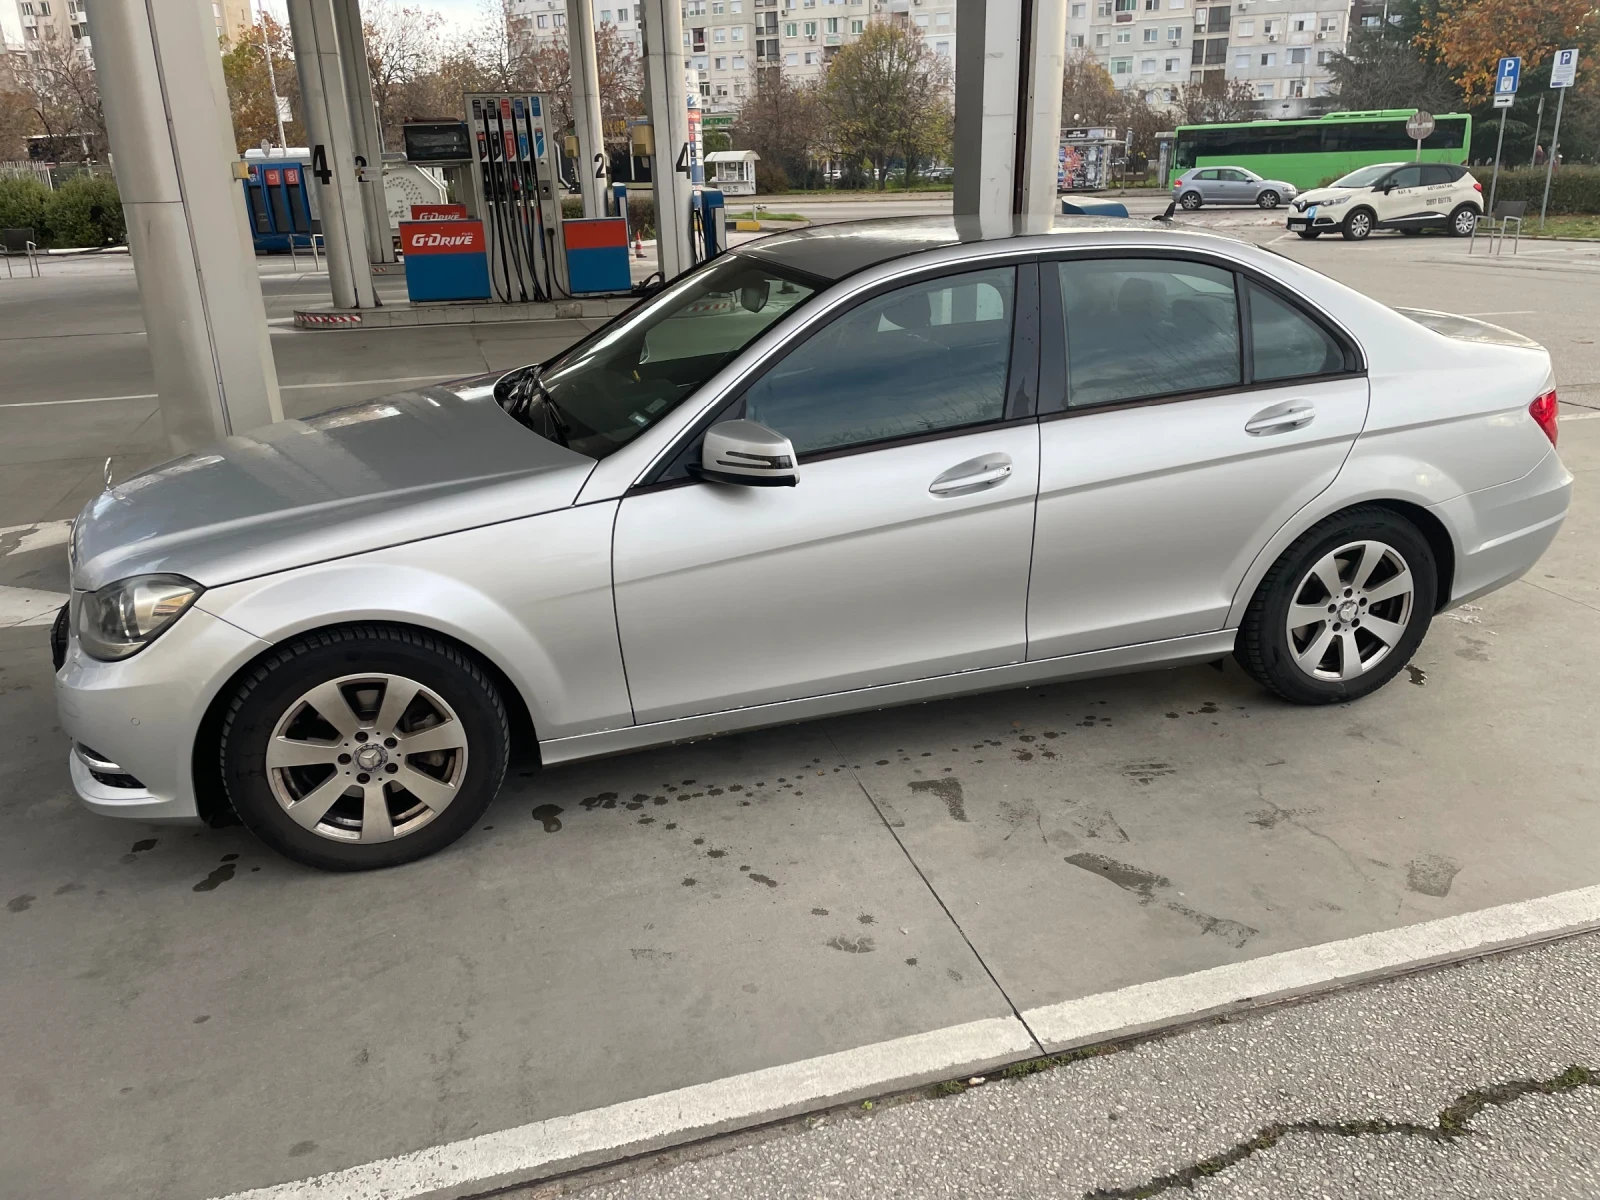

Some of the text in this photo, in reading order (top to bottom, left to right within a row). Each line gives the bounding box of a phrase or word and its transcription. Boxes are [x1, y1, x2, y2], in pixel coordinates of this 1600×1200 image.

[1504, 59, 1515, 77] P
[1562, 52, 1571, 64] P
[313, 144, 333, 185] 4
[594, 152, 606, 179] 2
[676, 142, 691, 180] 4
